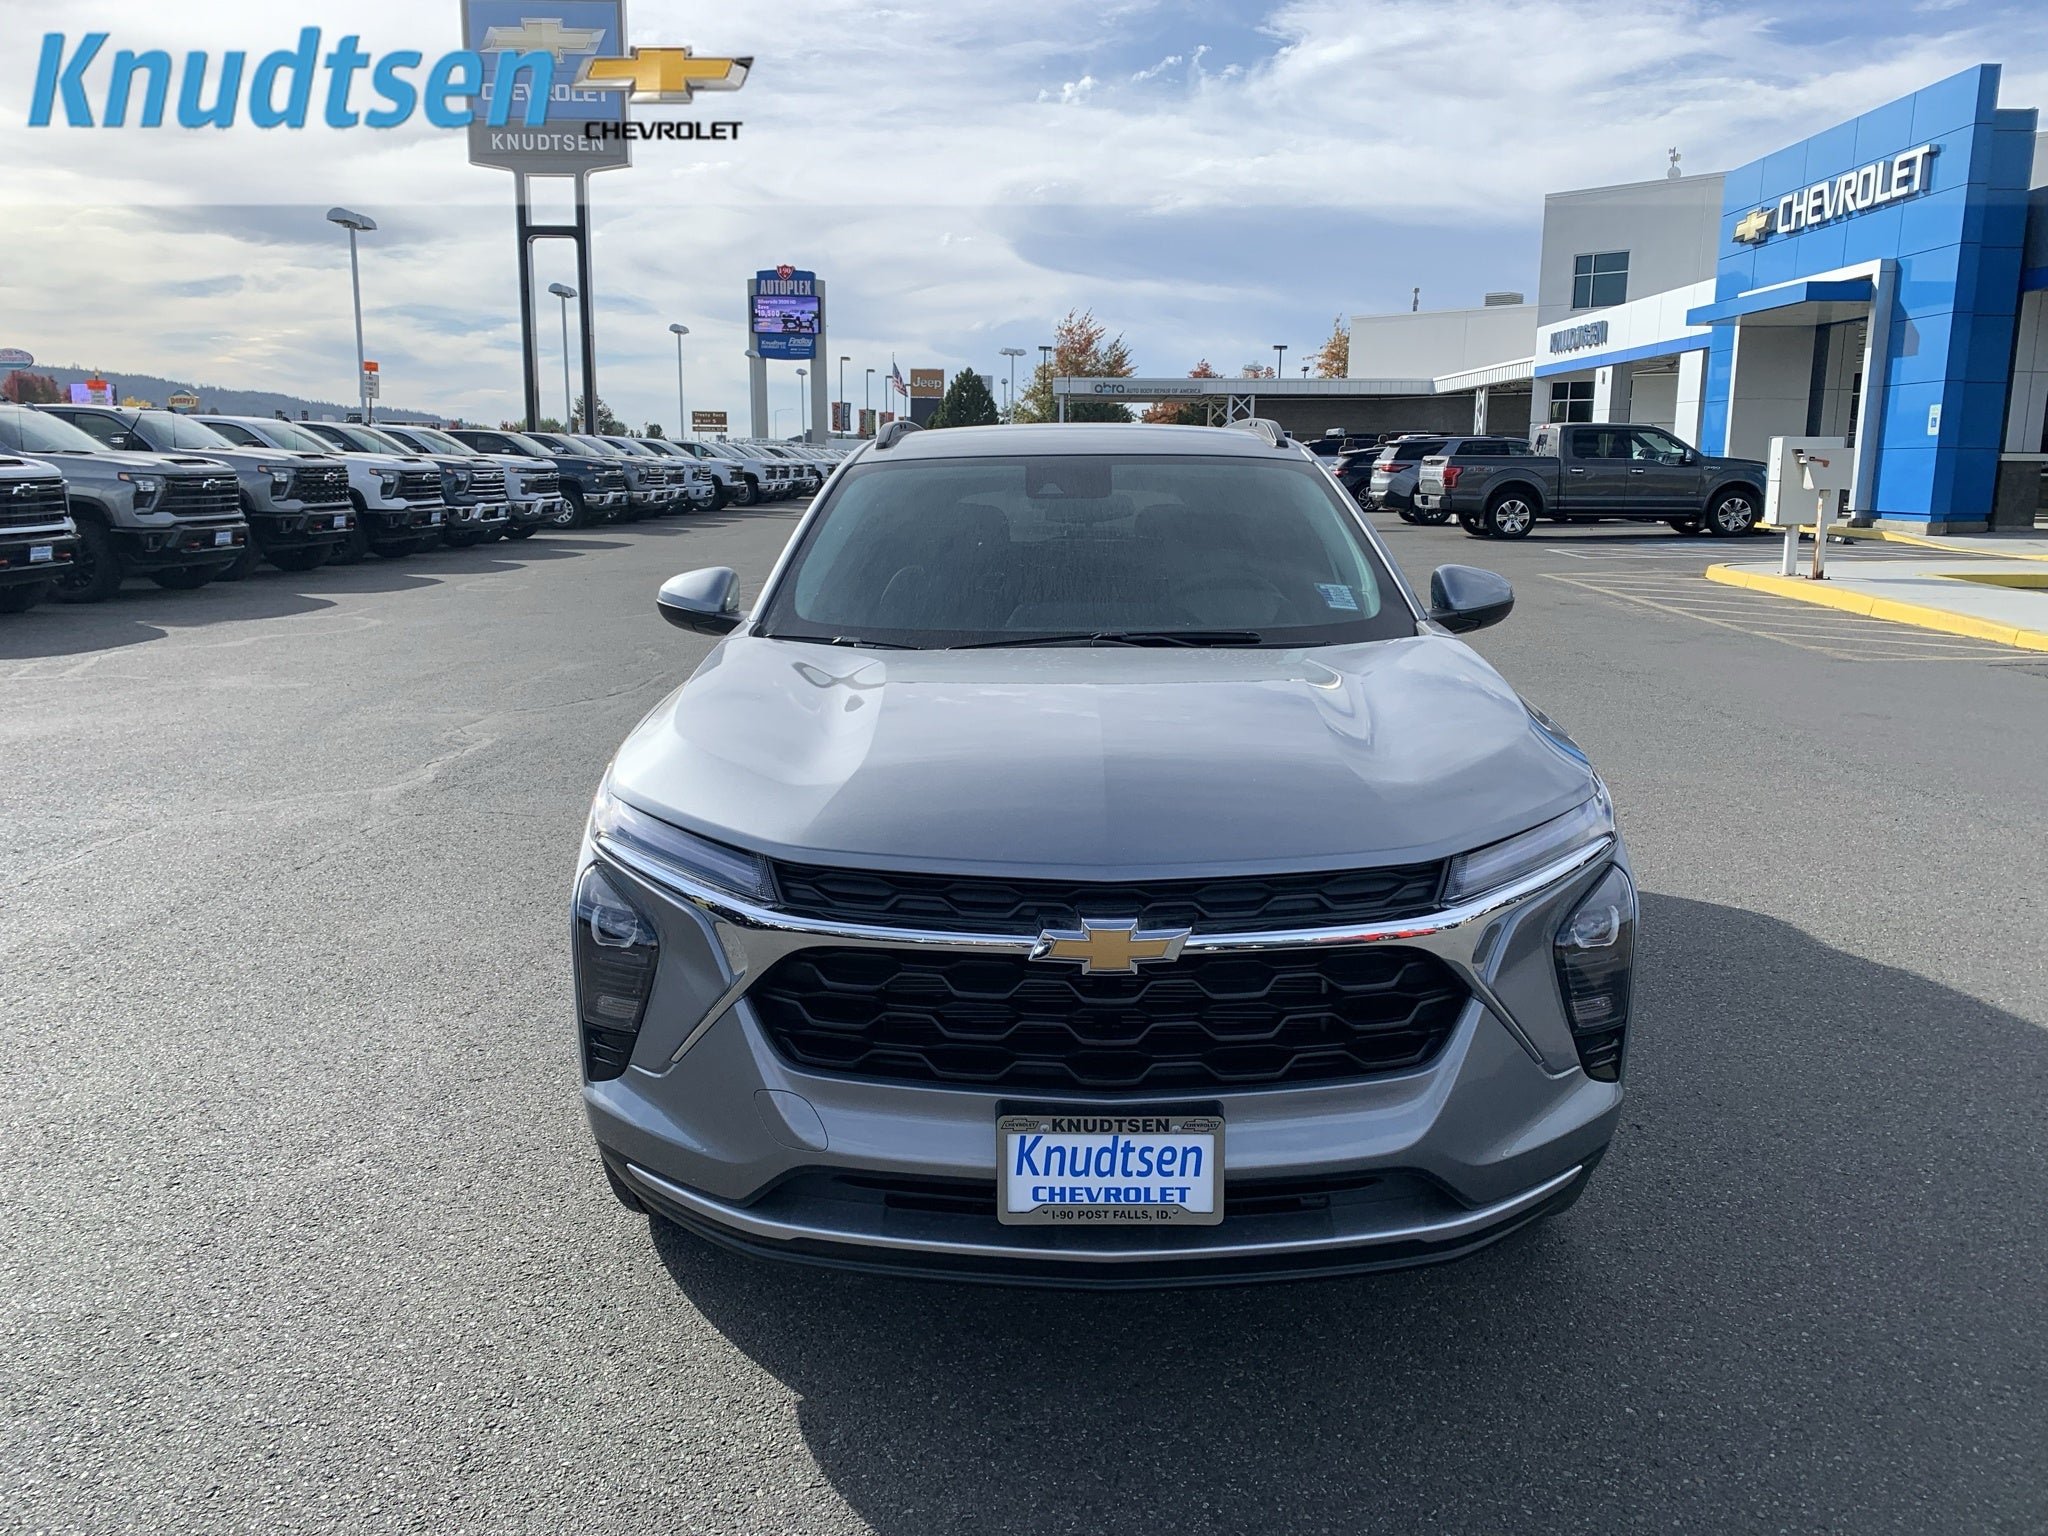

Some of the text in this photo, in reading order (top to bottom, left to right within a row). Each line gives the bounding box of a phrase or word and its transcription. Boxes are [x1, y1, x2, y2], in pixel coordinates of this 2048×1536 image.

[491, 133, 604, 152] KNUDTSEN
[1777, 144, 1932, 234] CHEVROLET
[760, 279, 811, 295] AUTOPLEX
[912, 376, 942, 389] Jeep
[1094, 382, 1125, 394] abra
[1051, 1118, 1170, 1133] KNUDTSEN
[1015, 1135, 1203, 1177] Knudtsen
[1031, 1186, 1191, 1203] CHEVROLET
[1052, 1210, 1172, 1222] I-90 POST FALLS, ID.
